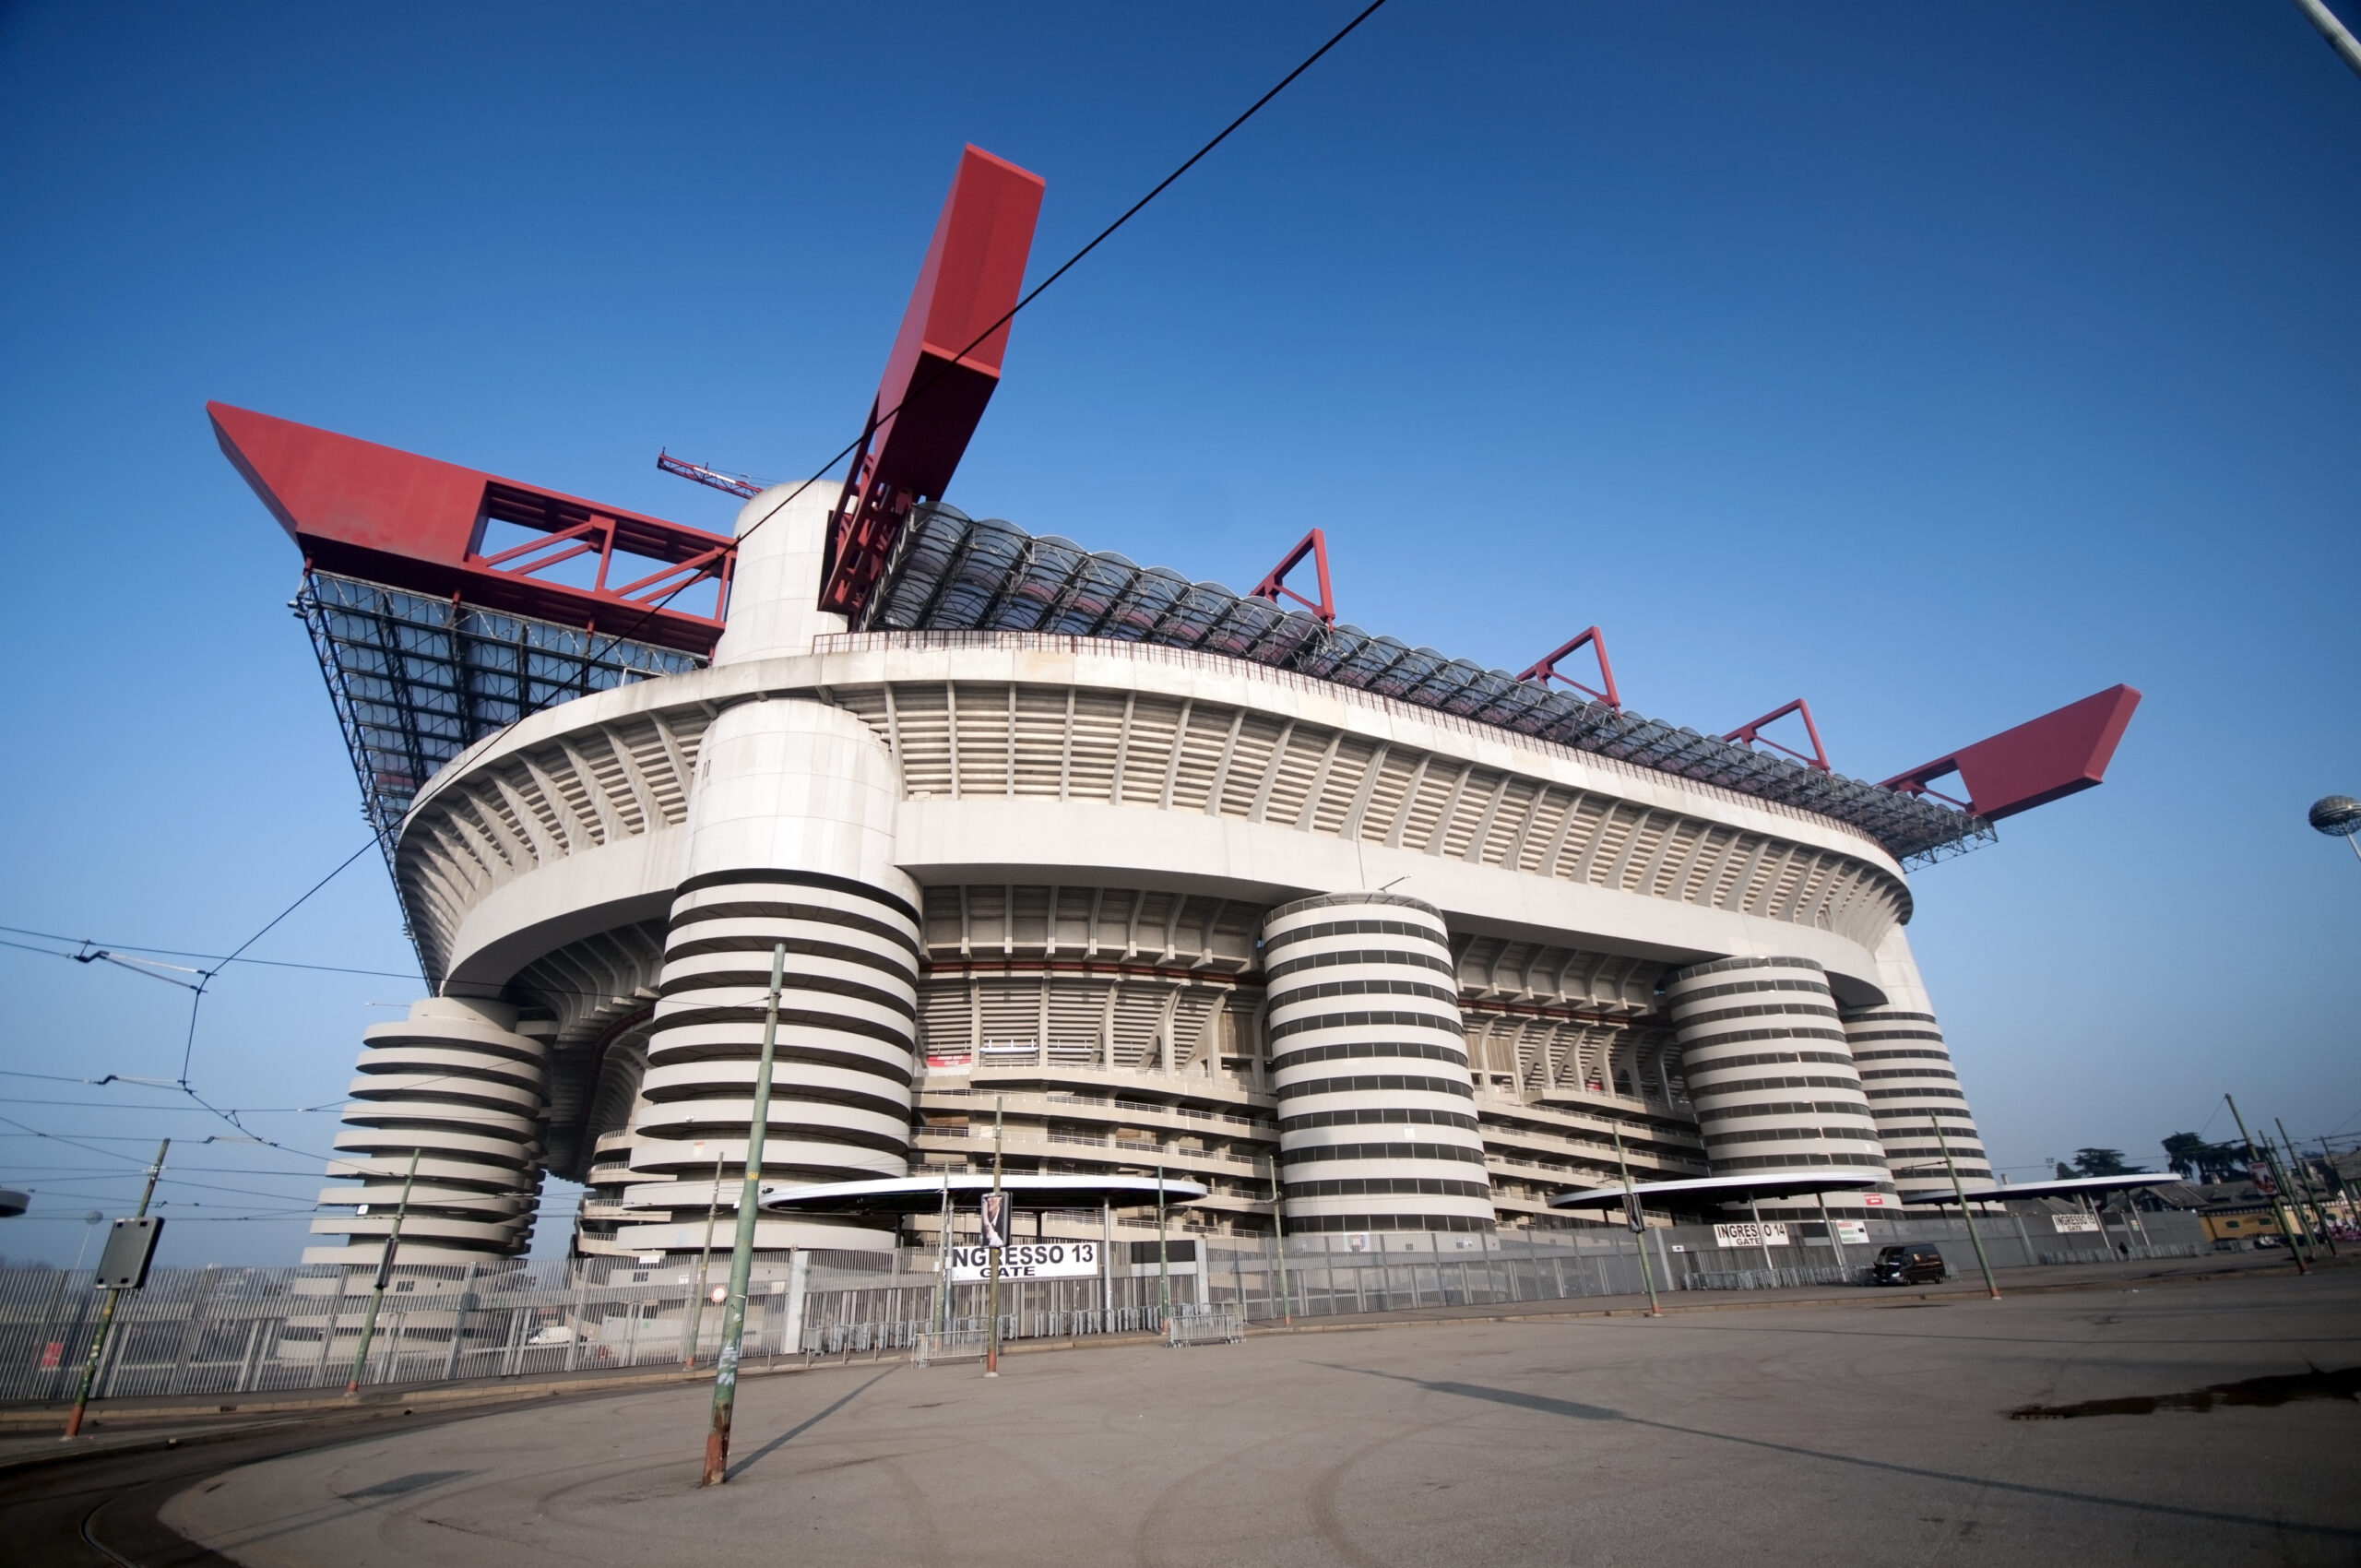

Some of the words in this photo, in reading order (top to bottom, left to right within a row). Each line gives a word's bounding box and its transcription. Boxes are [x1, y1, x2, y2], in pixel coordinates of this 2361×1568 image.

[2055, 1215, 2088, 1226] INGRESSO
[1716, 1224, 1771, 1238] INGRESO
[1774, 1223, 1786, 1236] 14
[1736, 1237, 1762, 1246] GATE
[944, 1245, 1063, 1267] NGRESSO
[1072, 1244, 1093, 1263] 13
[979, 1265, 1036, 1278] GATE
